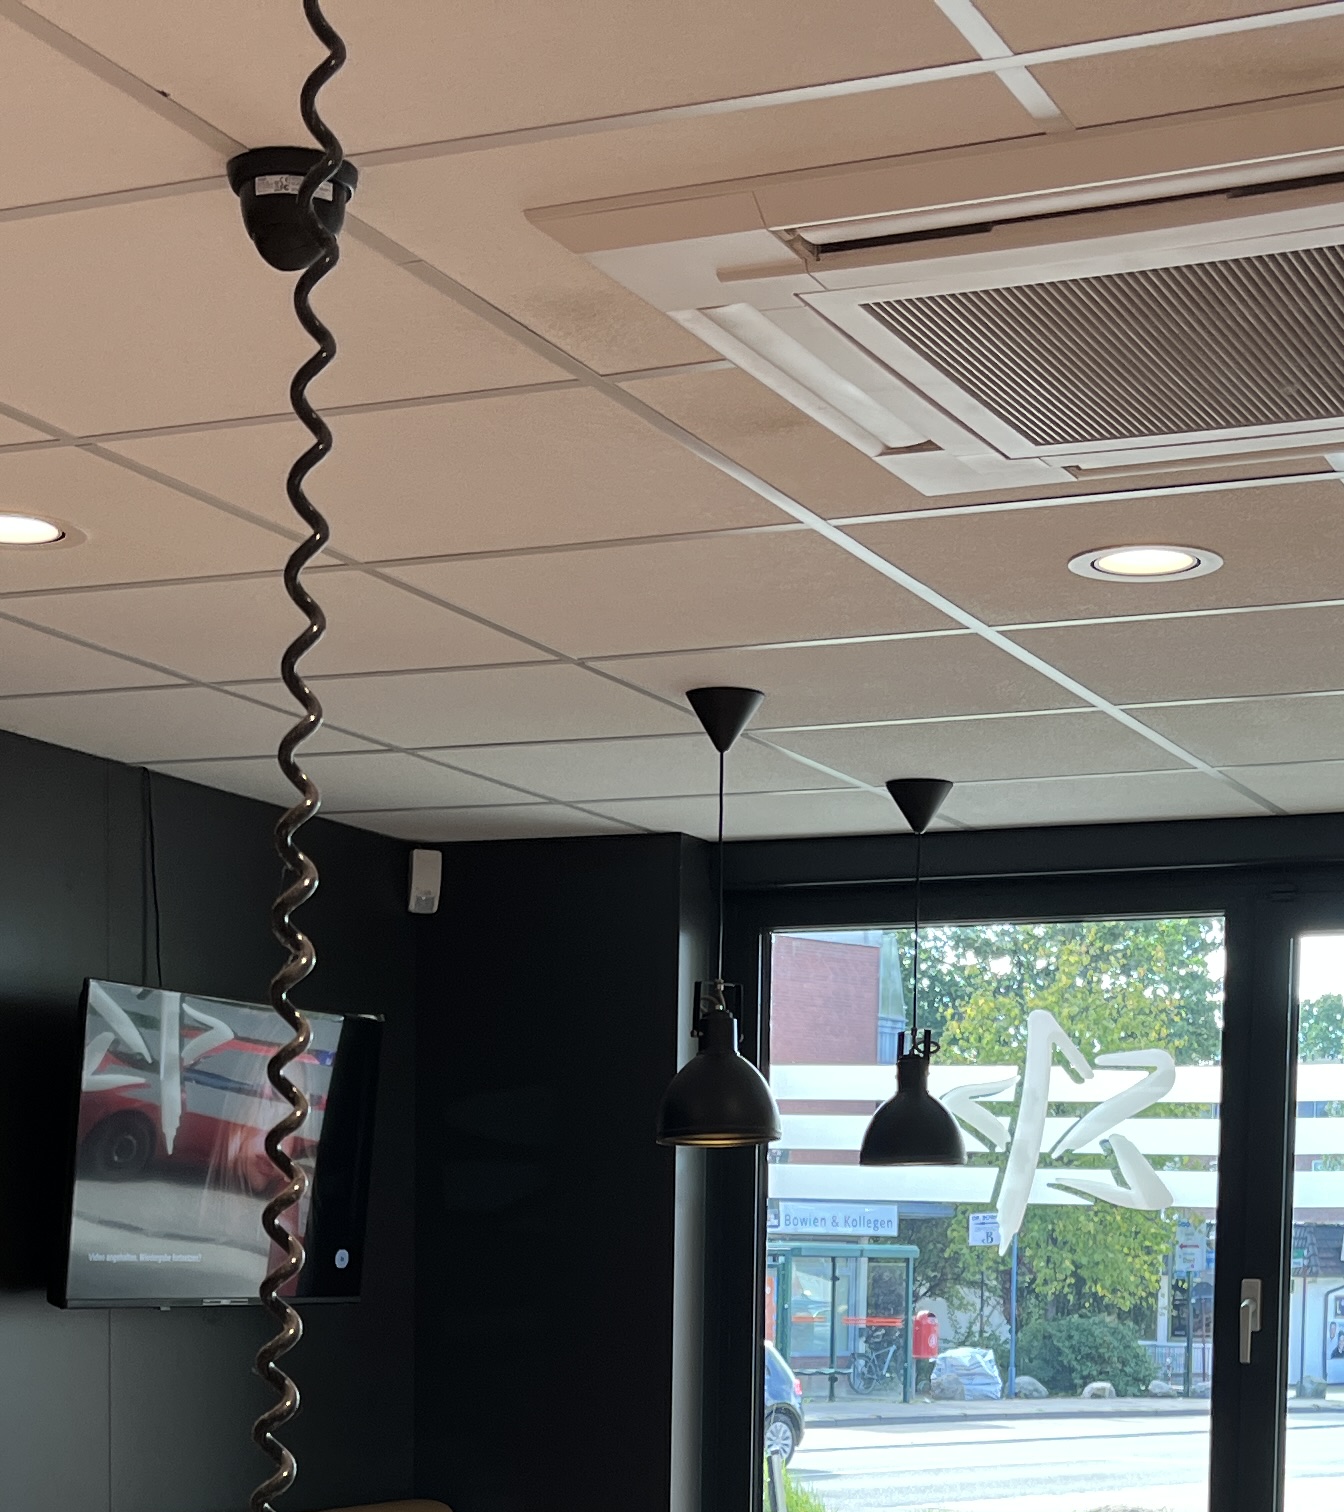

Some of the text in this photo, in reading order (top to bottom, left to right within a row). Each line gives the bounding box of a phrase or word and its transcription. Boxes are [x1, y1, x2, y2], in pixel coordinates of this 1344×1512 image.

[784, 1214, 894, 1232] Bowien & Kollegen
